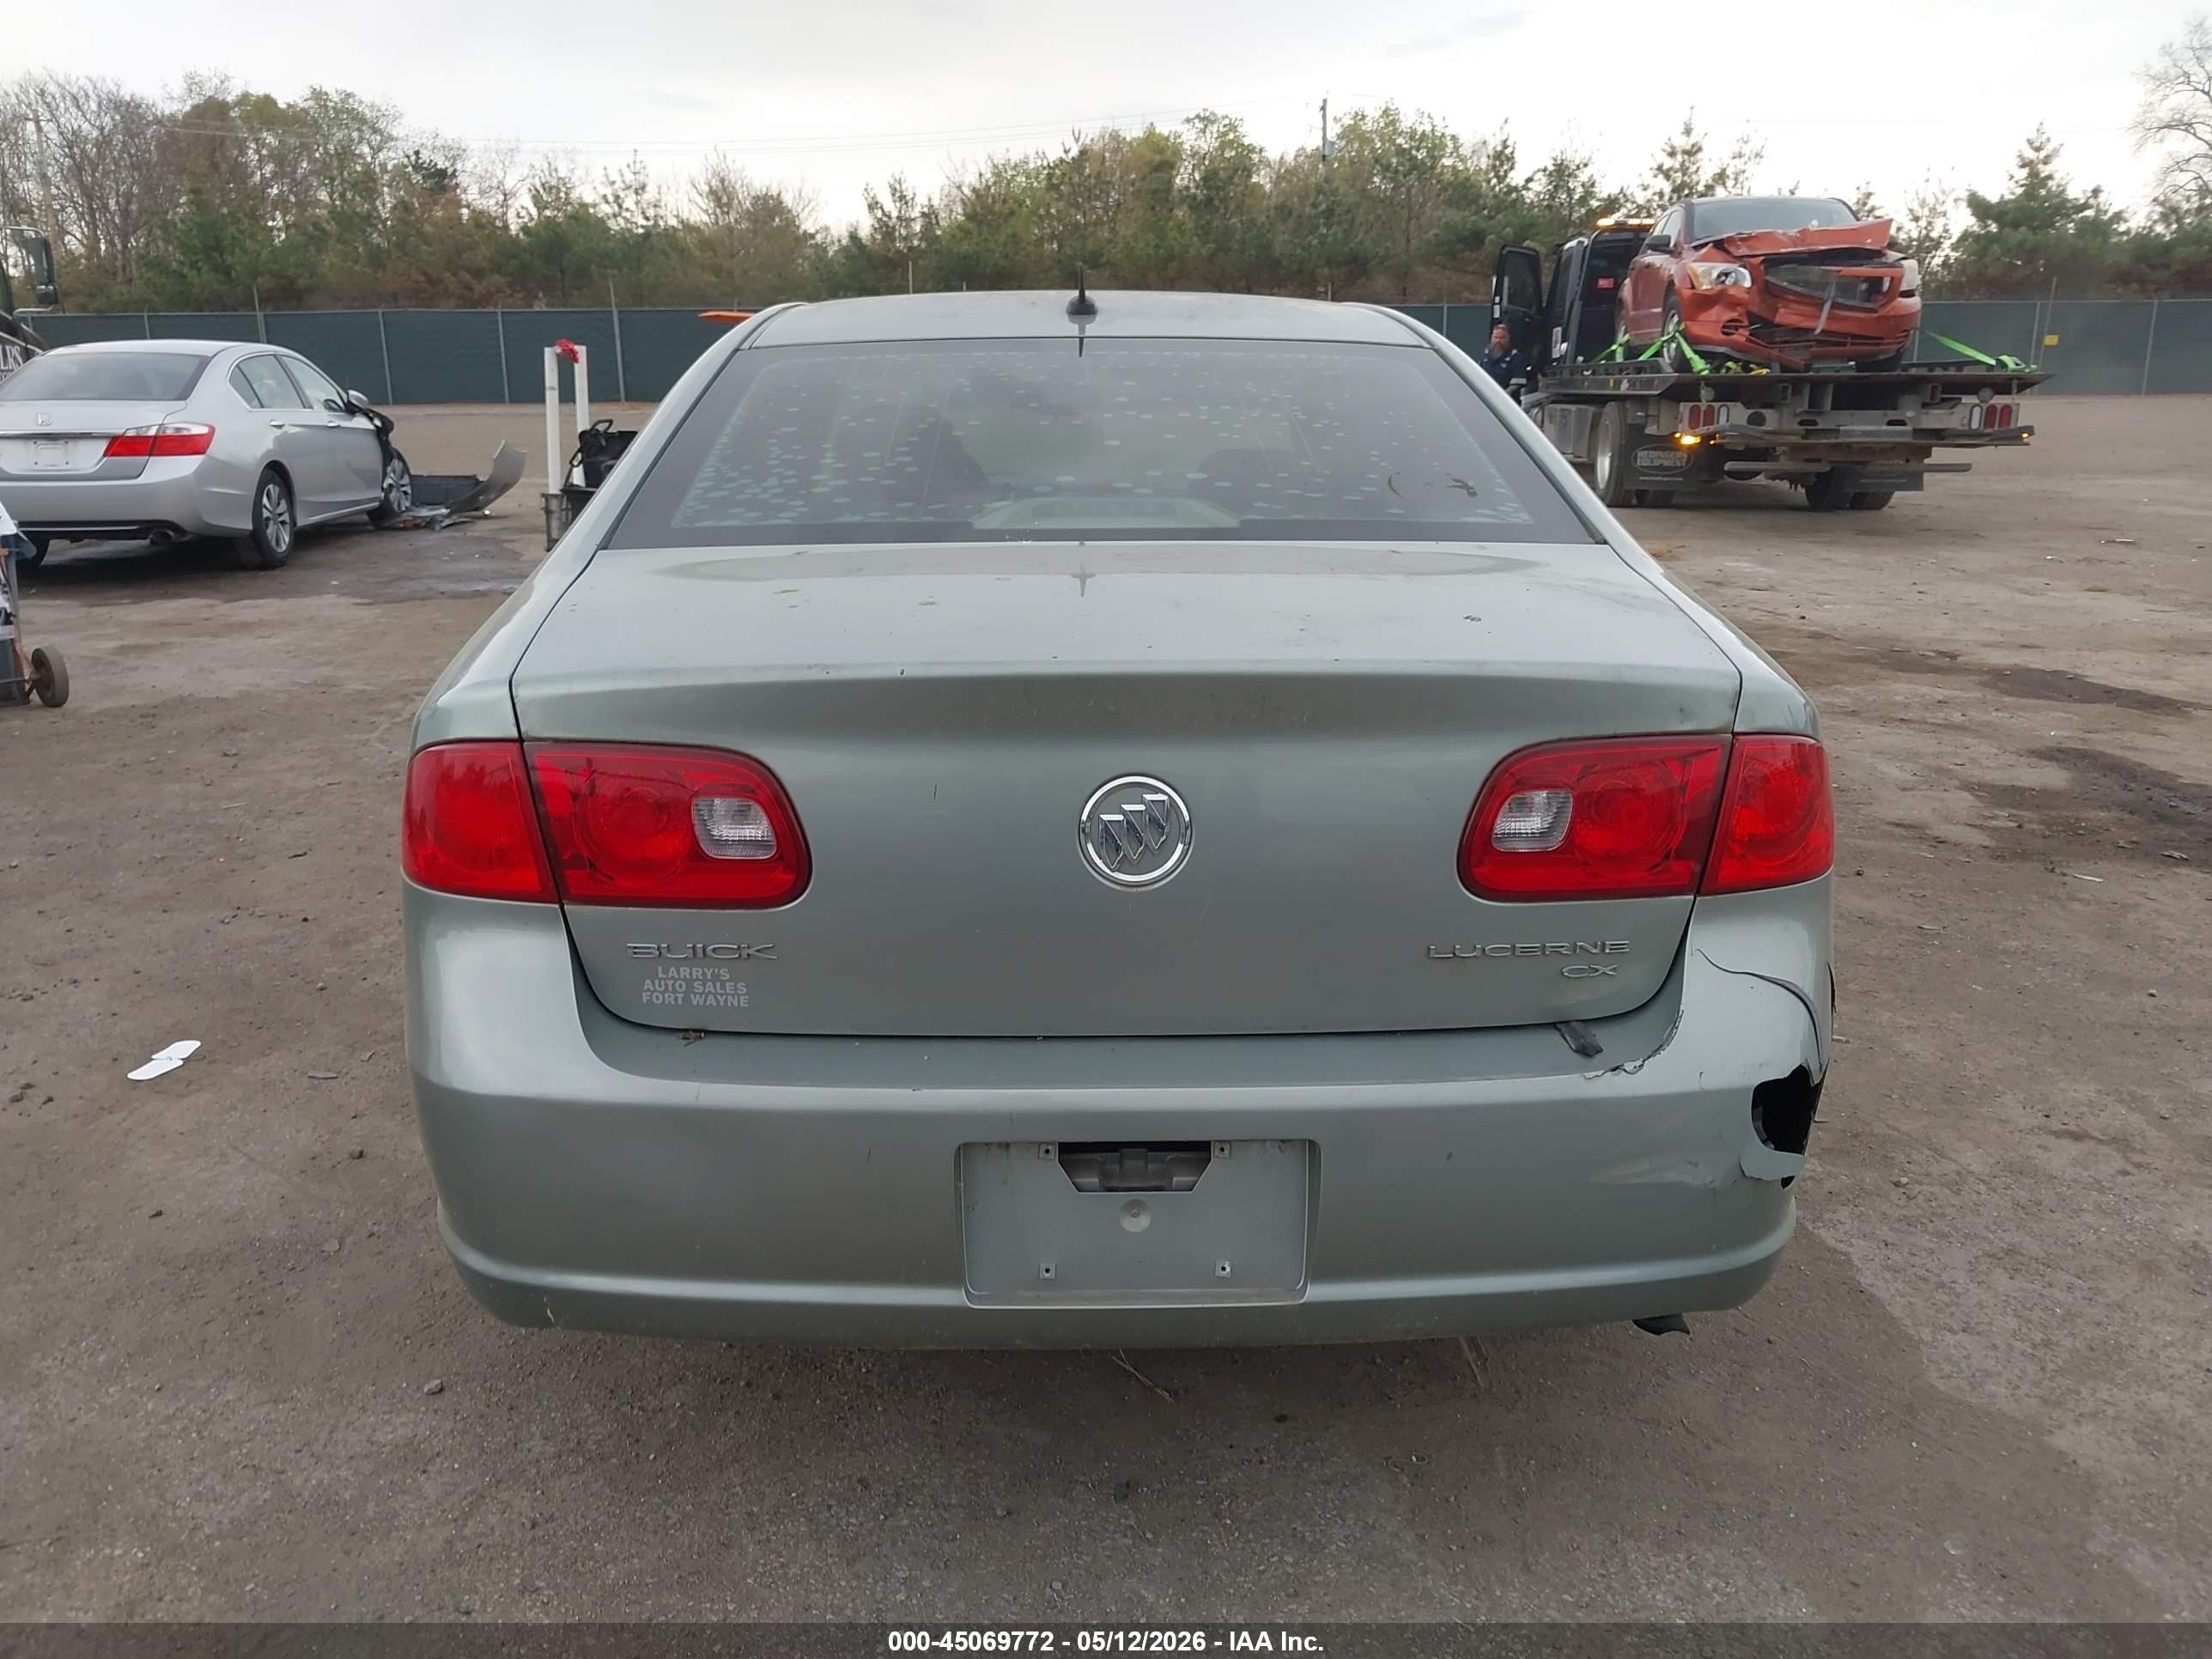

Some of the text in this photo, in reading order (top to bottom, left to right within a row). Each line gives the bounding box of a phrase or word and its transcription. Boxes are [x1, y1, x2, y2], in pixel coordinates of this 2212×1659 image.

[627, 943, 777, 959] BUICK
[1428, 940, 1631, 958] LUCERNE
[658, 965, 731, 981] LARRY'S
[1561, 963, 1619, 978] CX
[642, 979, 748, 994] AUTO SALES
[642, 992, 750, 1007] FORT WAYNE
